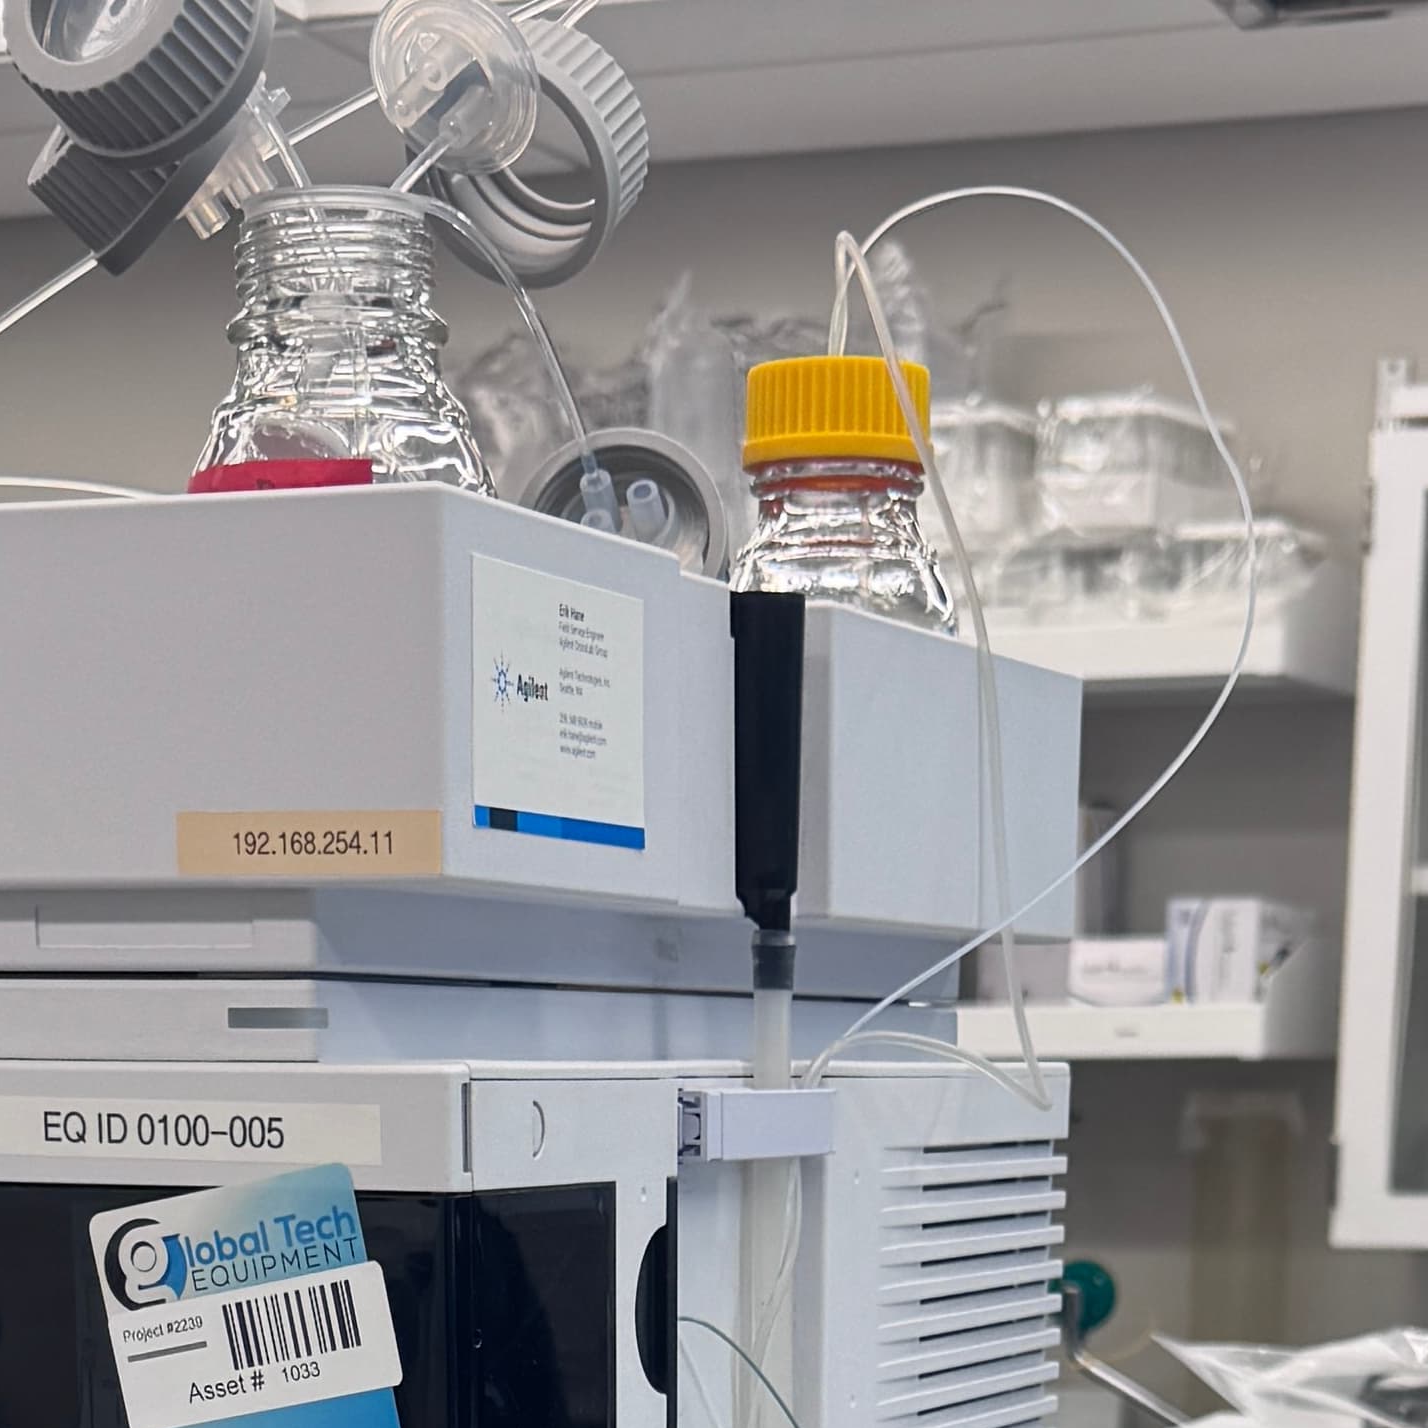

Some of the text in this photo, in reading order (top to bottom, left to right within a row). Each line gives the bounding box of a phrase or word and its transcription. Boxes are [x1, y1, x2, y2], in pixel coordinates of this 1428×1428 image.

[517, 674, 549, 702] Agilent
[233, 830, 394, 856] 192.168.254.11
[42, 1111, 286, 1150] EQ ID 0100-005
[275, 1206, 357, 1248] Tech
[191, 1236, 360, 1293] EQUIPMENT
[123, 1324, 165, 1343] Project
[188, 1360, 322, 1404] Asset # 1033
